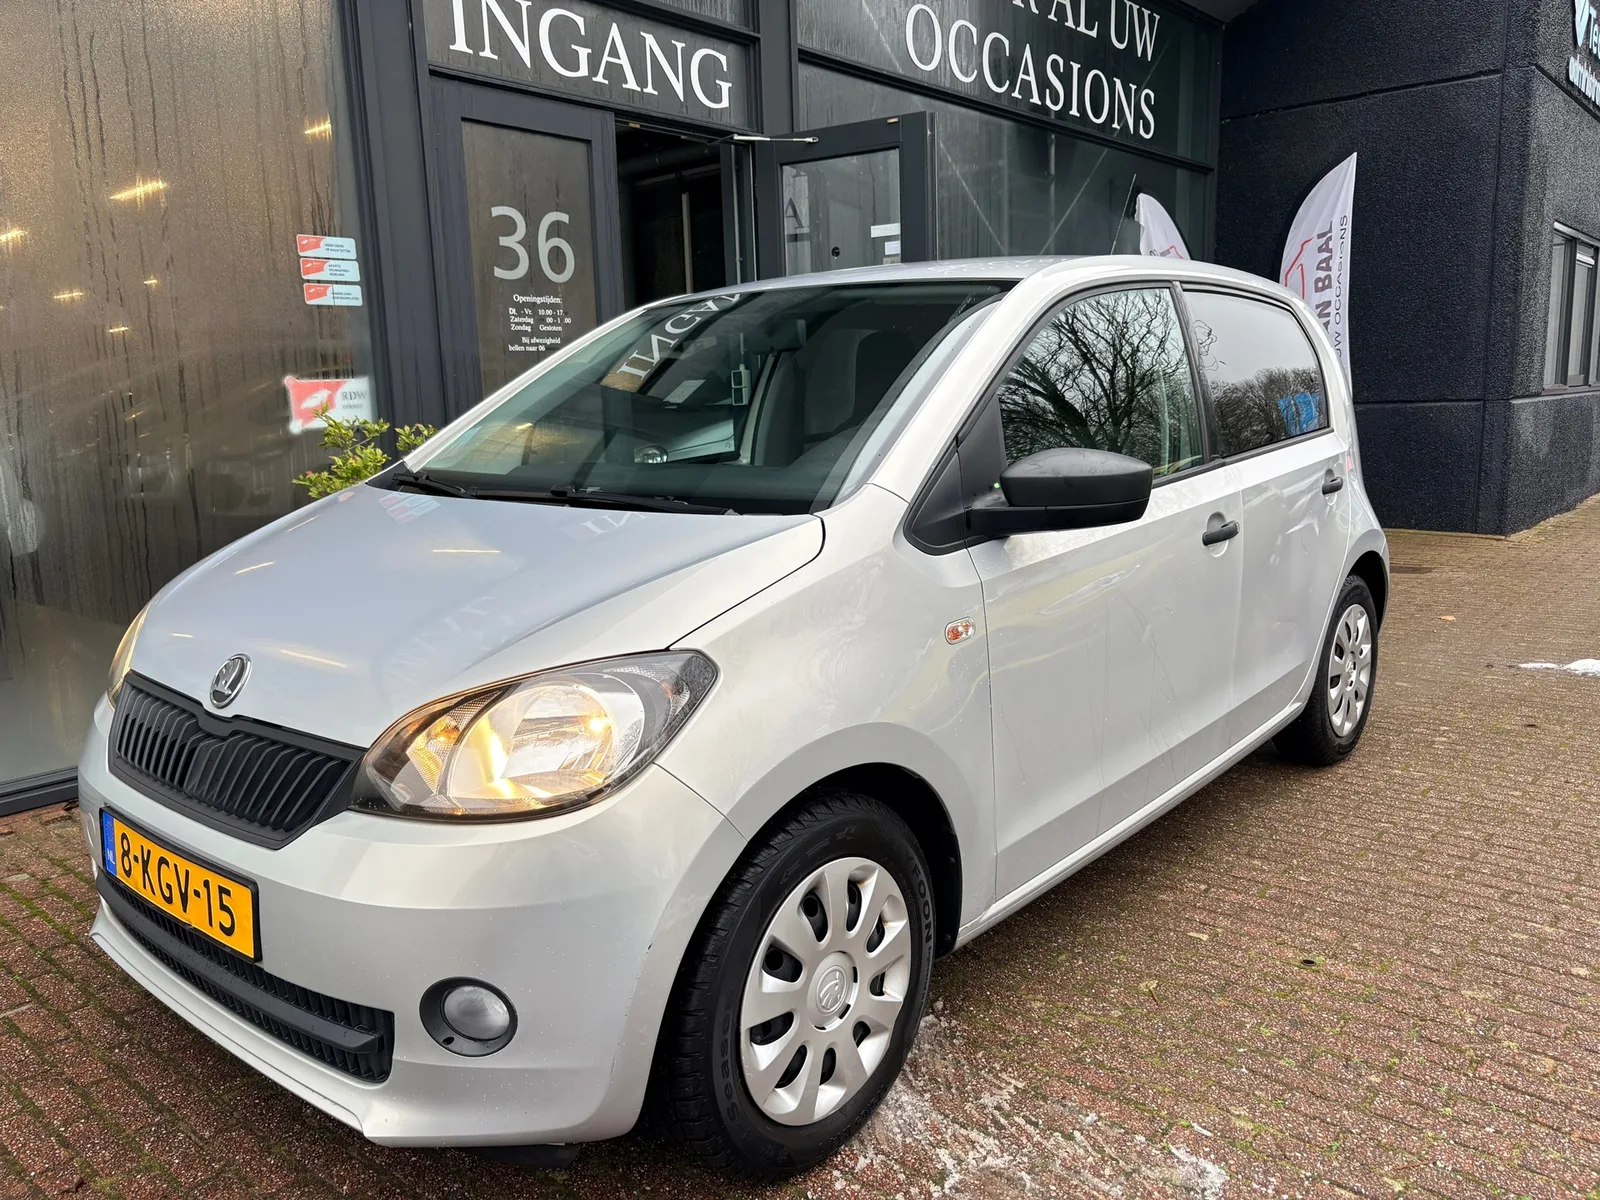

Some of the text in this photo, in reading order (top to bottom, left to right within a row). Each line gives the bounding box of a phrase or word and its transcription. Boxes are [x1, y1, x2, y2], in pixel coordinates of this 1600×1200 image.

[450, 0, 733, 108] INGANG
[1110, 0, 1161, 61] UW
[905, 3, 1156, 139] OCCASIONS
[491, 206, 575, 283] 36
[1314, 220, 1333, 293] BAAL
[1334, 215, 1349, 325] OCCASIONS
[510, 316, 534, 324] Zaterdag
[511, 324, 532, 332] Zondag
[513, 294, 562, 304] Openingstijden:
[508, 344, 525, 352] bellen
[531, 337, 561, 345] afwezigheid
[120, 832, 236, 937] 8-KGV-15
